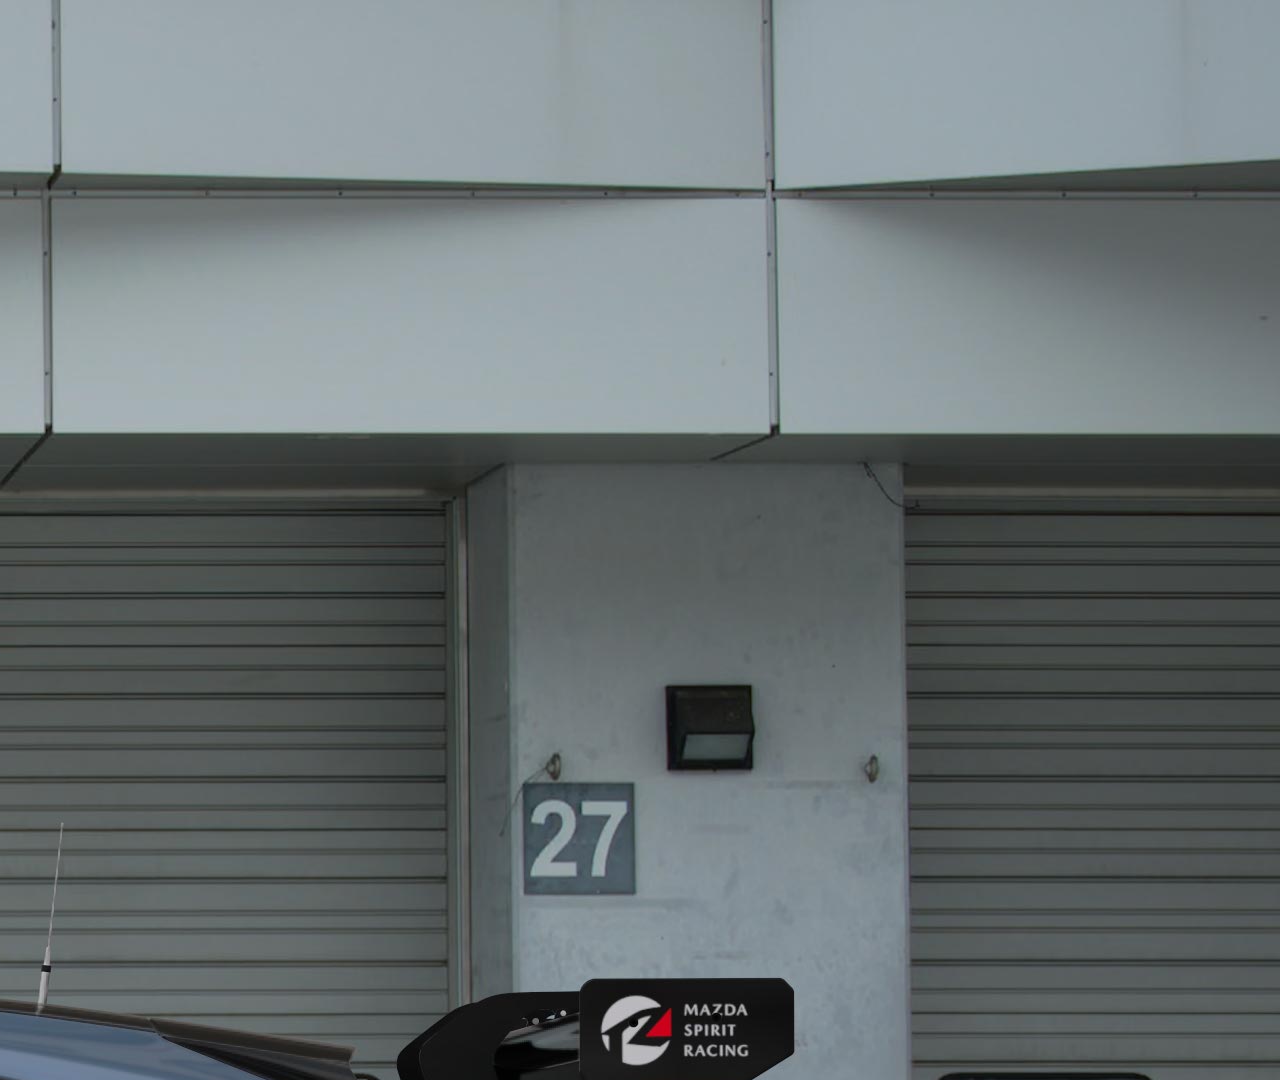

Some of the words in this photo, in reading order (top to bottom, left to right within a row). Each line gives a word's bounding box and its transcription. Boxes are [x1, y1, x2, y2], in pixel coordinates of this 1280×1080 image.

[530, 799, 627, 877] 27
[684, 1003, 748, 1017] MAZDA
[684, 1024, 736, 1038] SPIRIT
[684, 1044, 749, 1058] RACING
